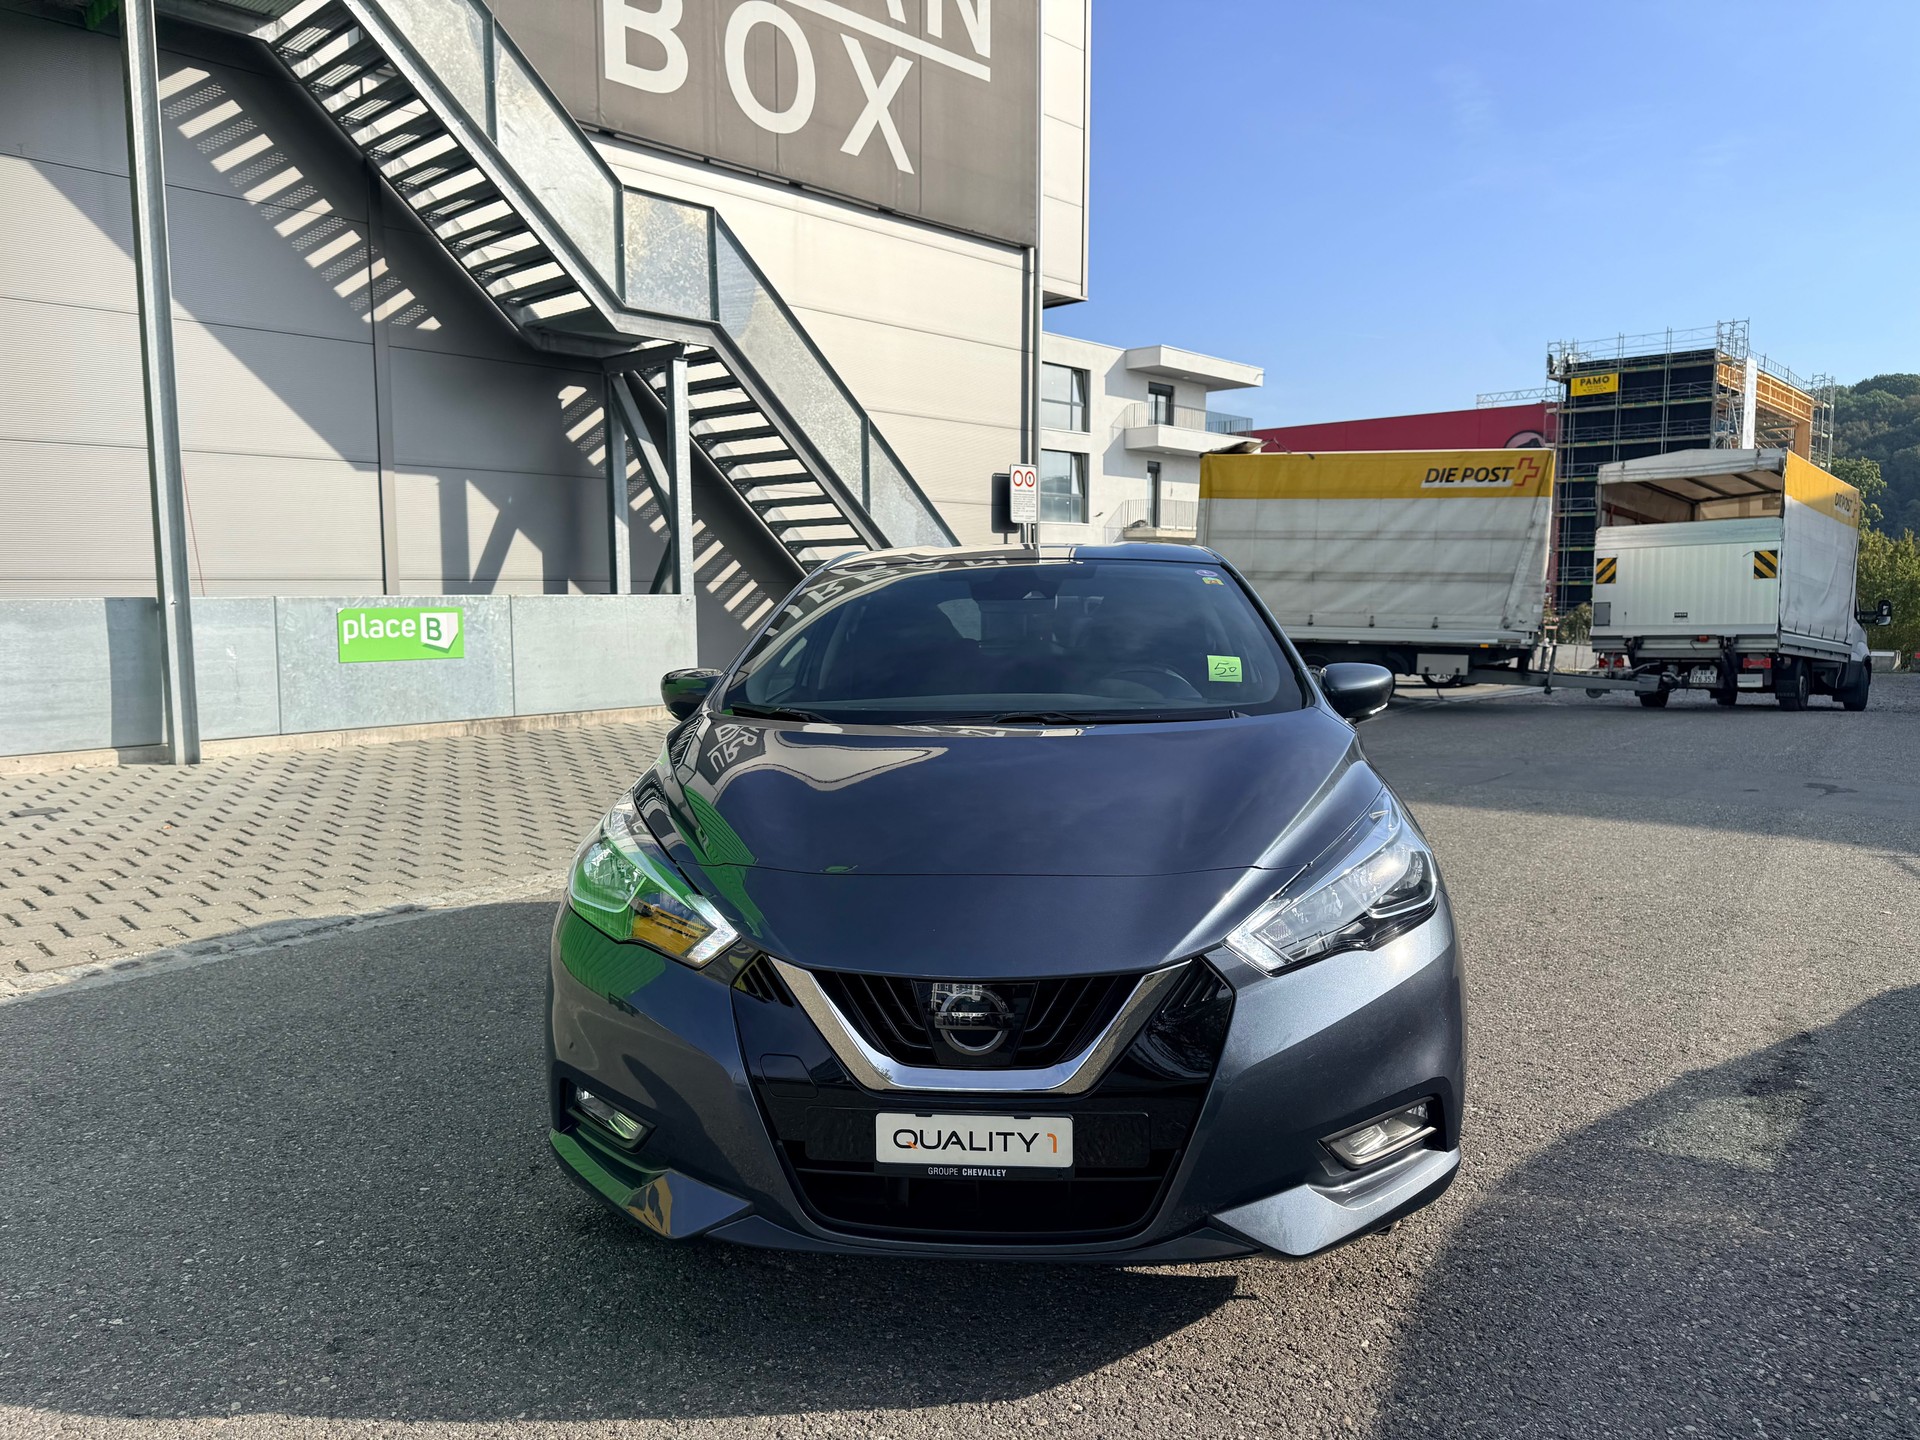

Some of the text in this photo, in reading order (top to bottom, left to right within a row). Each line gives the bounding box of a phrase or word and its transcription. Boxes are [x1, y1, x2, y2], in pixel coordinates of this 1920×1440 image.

[603, 0, 914, 174] BOX
[1580, 375, 1610, 386] PAMO
[1425, 467, 1515, 483] DIE POST
[343, 613, 416, 645] place
[1214, 662, 1237, 675] 50
[892, 1128, 1039, 1153] QUALITY
[928, 1167, 1007, 1177] GROUPE CHEVALLEY
